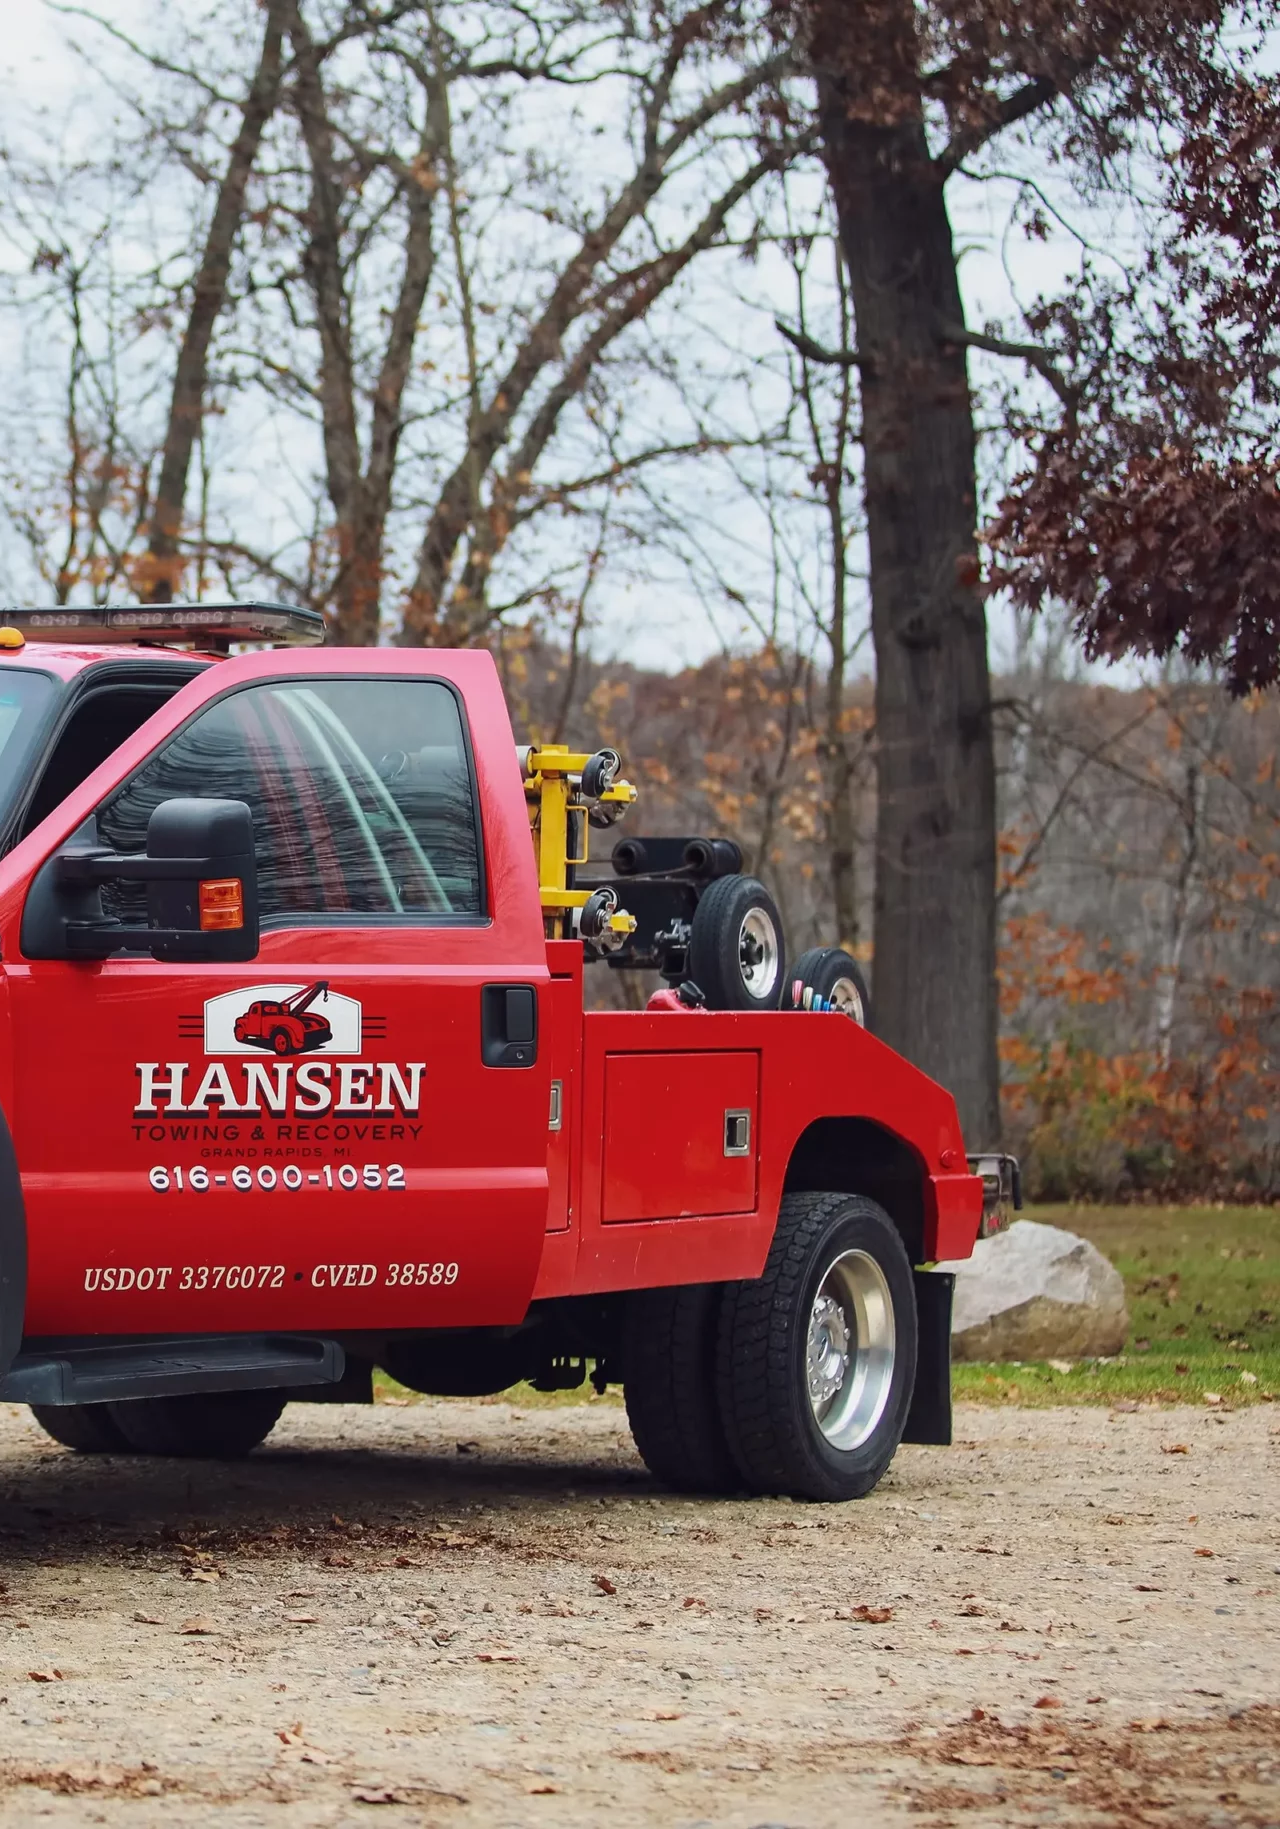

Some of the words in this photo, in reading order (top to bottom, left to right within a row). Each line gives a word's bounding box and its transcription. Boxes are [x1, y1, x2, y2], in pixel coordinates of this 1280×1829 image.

[132, 1062, 426, 1119] HANSEN
[131, 1125, 240, 1142] TOWING
[250, 1124, 266, 1141] &
[276, 1124, 424, 1141] RECOVERY
[200, 1147, 258, 1158] GRAND
[148, 1163, 407, 1192] 616-600-1052
[83, 1267, 172, 1292] USDOT
[310, 1264, 378, 1288] CVED
[384, 1262, 460, 1286] 38589
